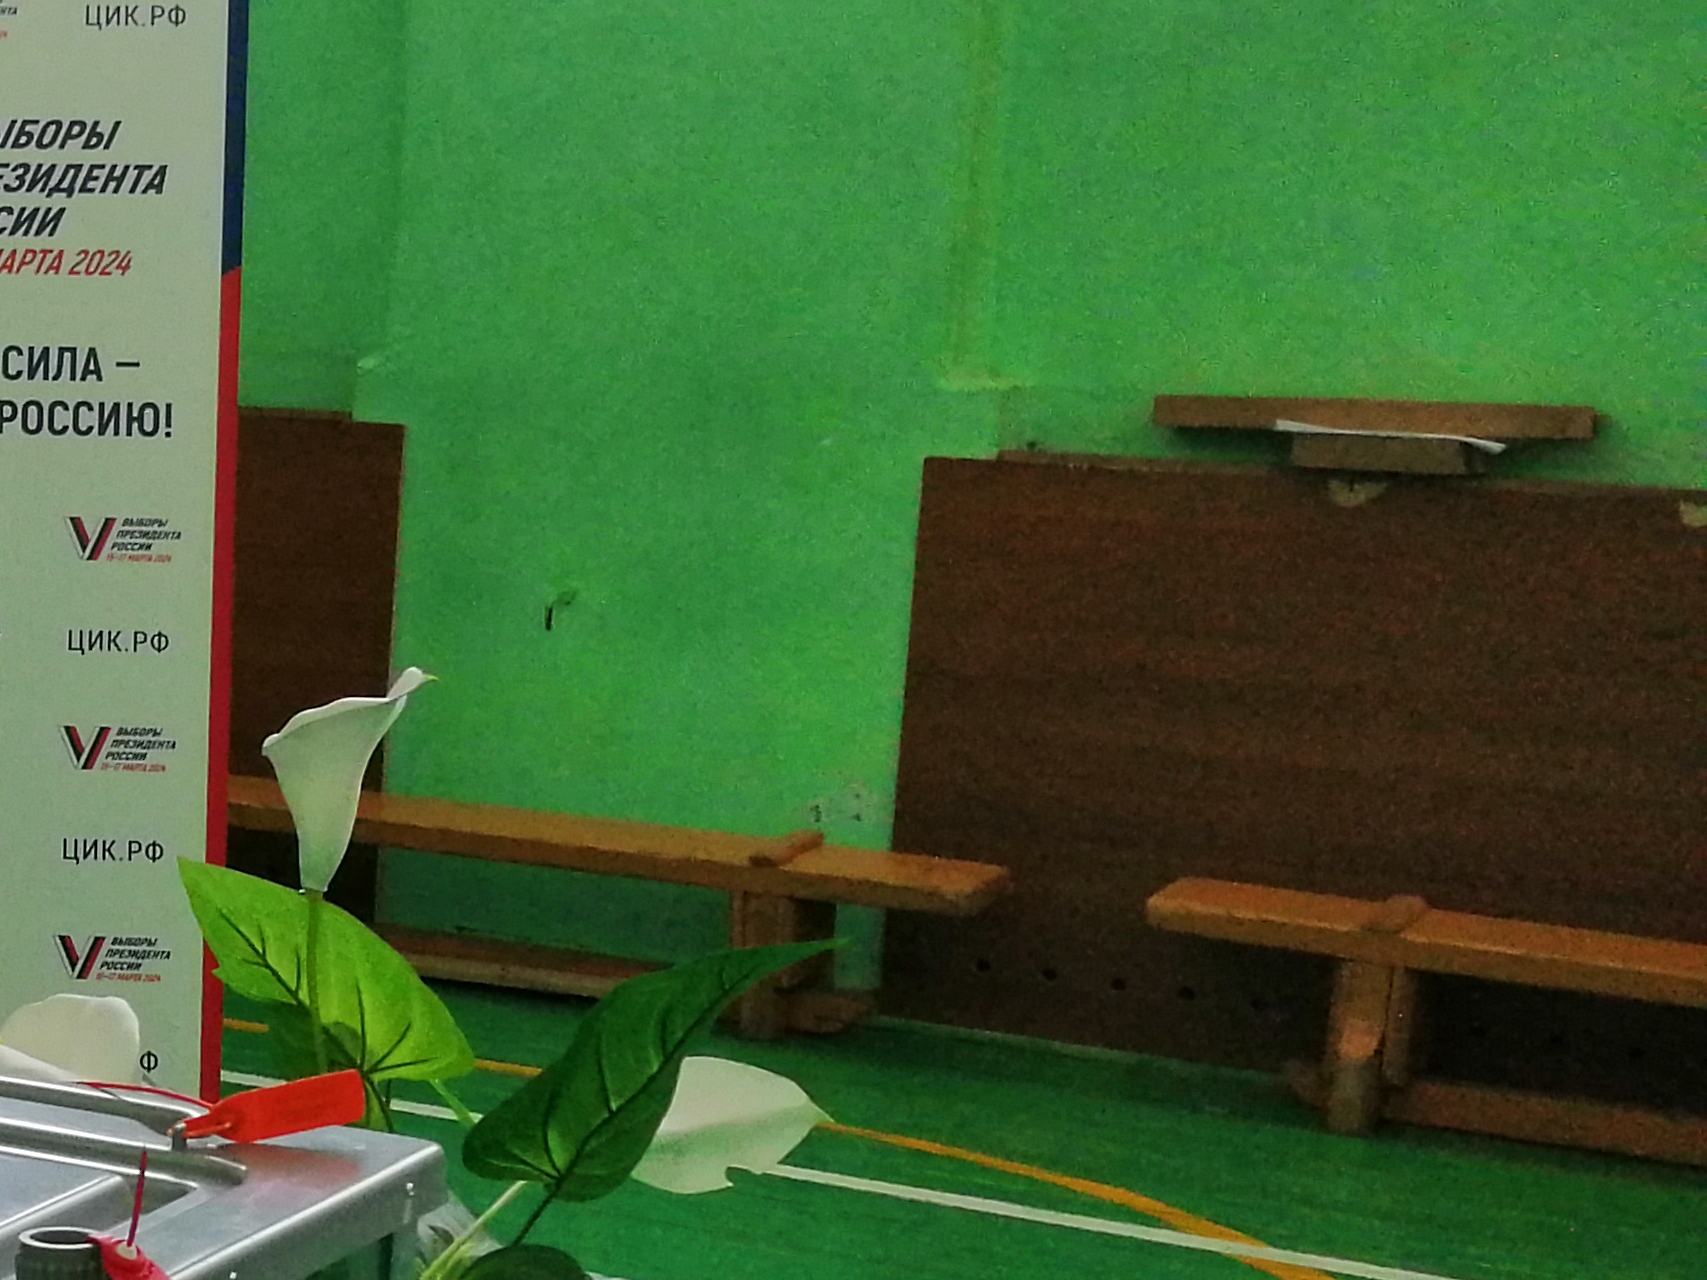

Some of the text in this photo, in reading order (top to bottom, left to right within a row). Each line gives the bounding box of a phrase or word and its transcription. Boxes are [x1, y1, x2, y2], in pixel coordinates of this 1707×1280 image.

[85, 4, 186, 31] ЦИК.РФ
[67, 249, 133, 277] 2024
[1, 344, 104, 382] СИЛА
[111, 542, 153, 551] РОССИИ
[67, 629, 169, 656] ЦИК.РФ
[106, 752, 148, 760] РОССИИ
[62, 837, 164, 865] ЦИК.РФ
[100, 962, 142, 971] РОССИИ
